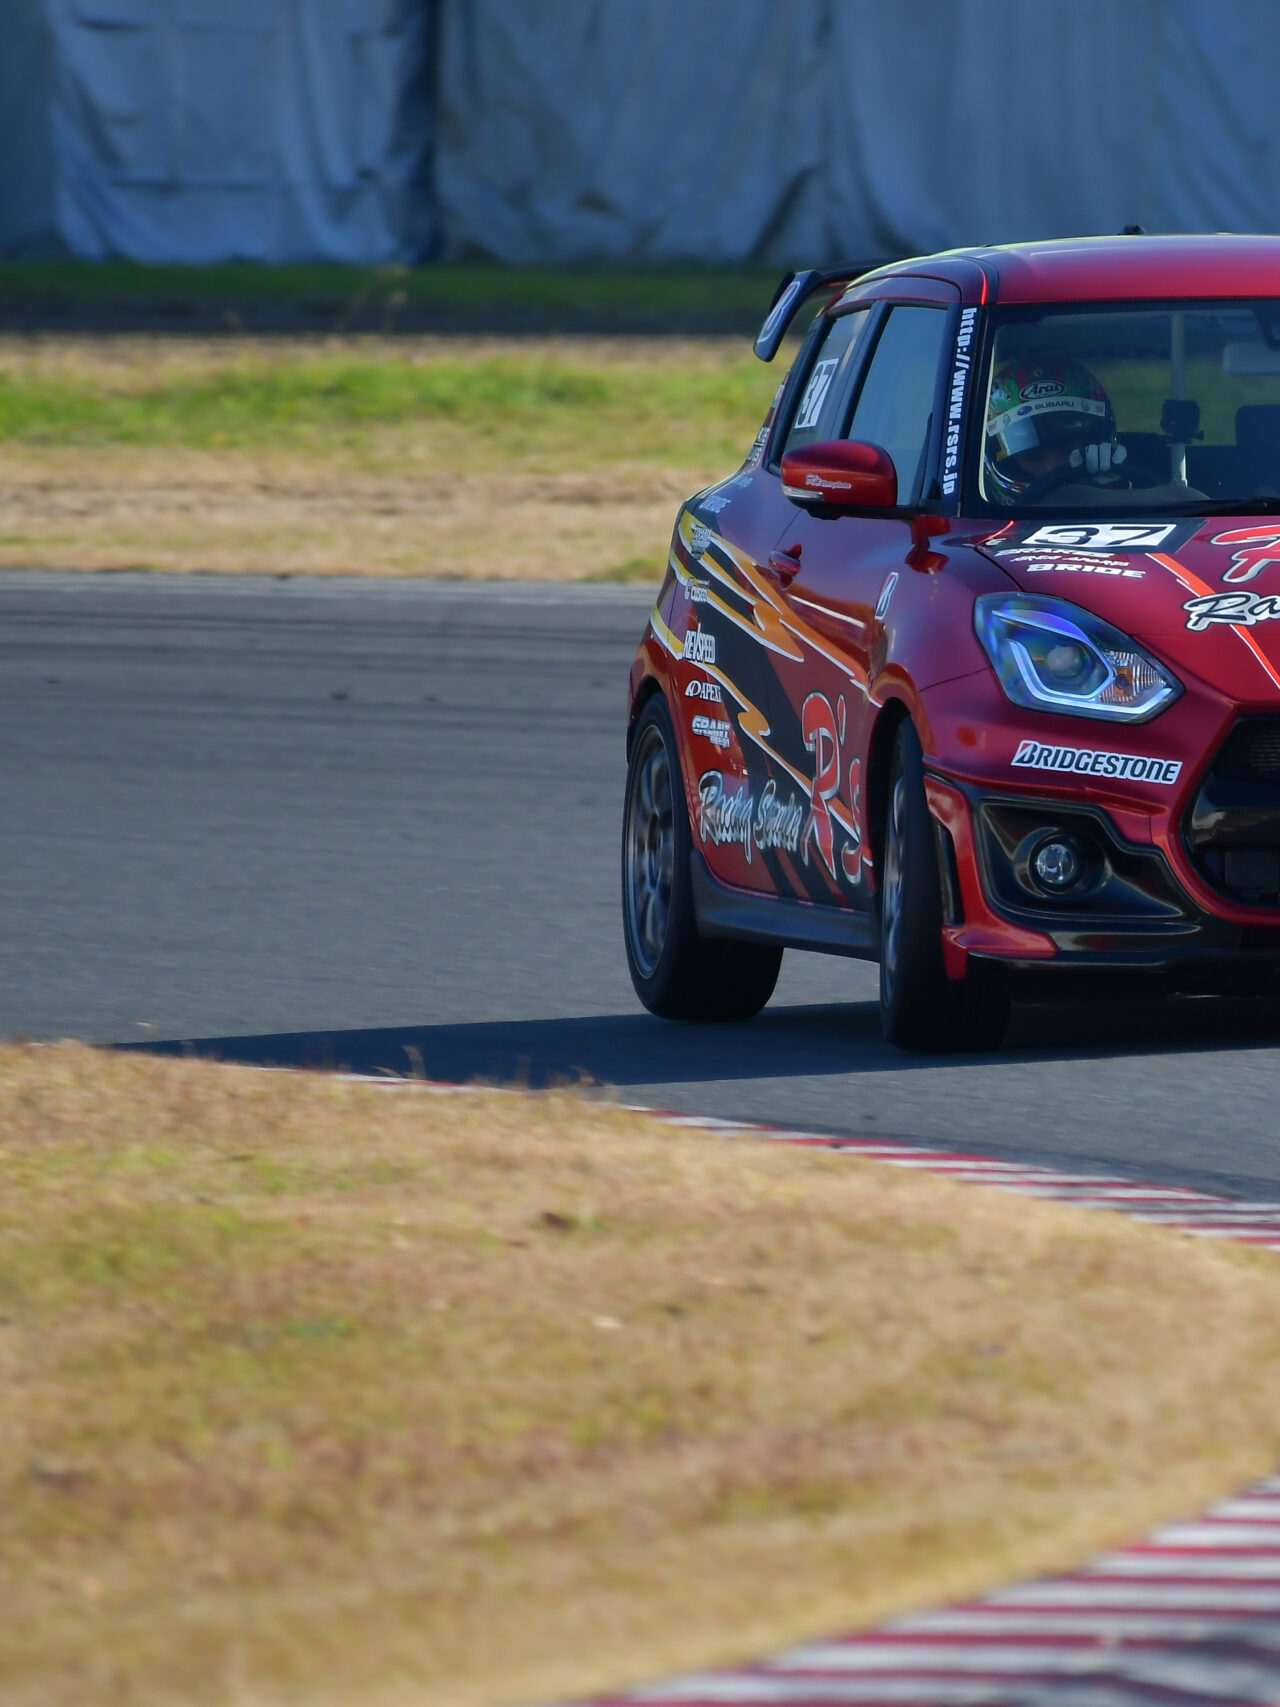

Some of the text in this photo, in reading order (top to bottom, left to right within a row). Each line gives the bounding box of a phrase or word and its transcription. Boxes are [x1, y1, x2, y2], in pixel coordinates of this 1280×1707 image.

[797, 362, 837, 427] 37
[1027, 381, 1061, 396] Arai
[1040, 526, 1168, 547] 37
[1026, 563, 1147, 579] BRIDE
[1014, 742, 1179, 782] BRIDGESTONE
